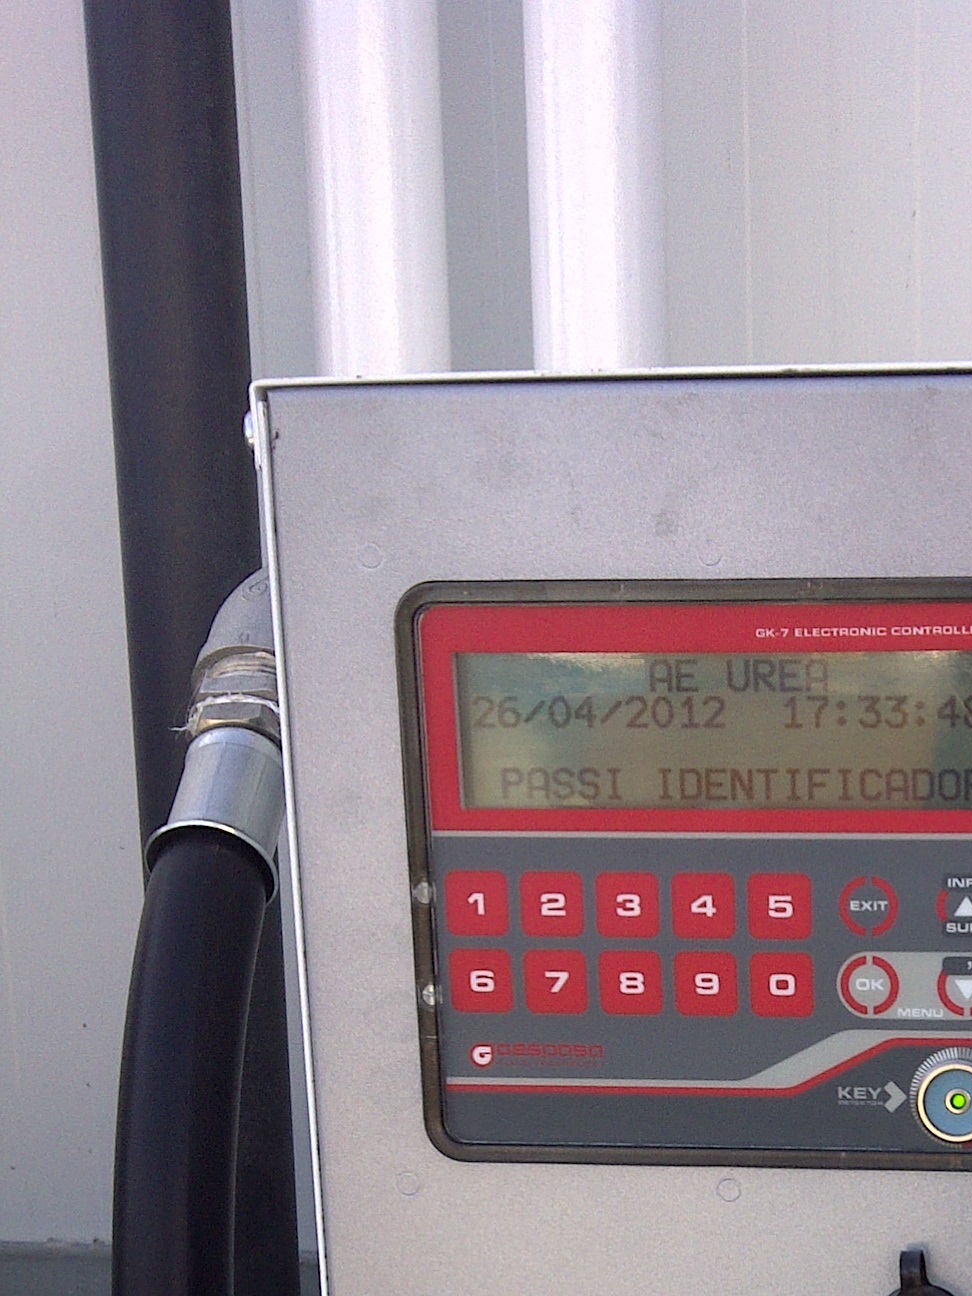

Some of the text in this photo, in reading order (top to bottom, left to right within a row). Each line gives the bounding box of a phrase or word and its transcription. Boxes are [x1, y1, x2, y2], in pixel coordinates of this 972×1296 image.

[755, 626, 790, 638] GK-7
[794, 626, 887, 638] ELECTRONIC
[649, 658, 829, 693] AE UREA
[473, 695, 726, 730] 26/04/2012
[502, 767, 622, 801] PASSI
[467, 892, 794, 919] 1 2 3 4 5
[849, 900, 888, 912] EXIT
[469, 970, 796, 996] 6 7 8 9 0
[855, 978, 885, 991] OK
[897, 1008, 944, 1018] MENU
[837, 1086, 882, 1100] KEY
